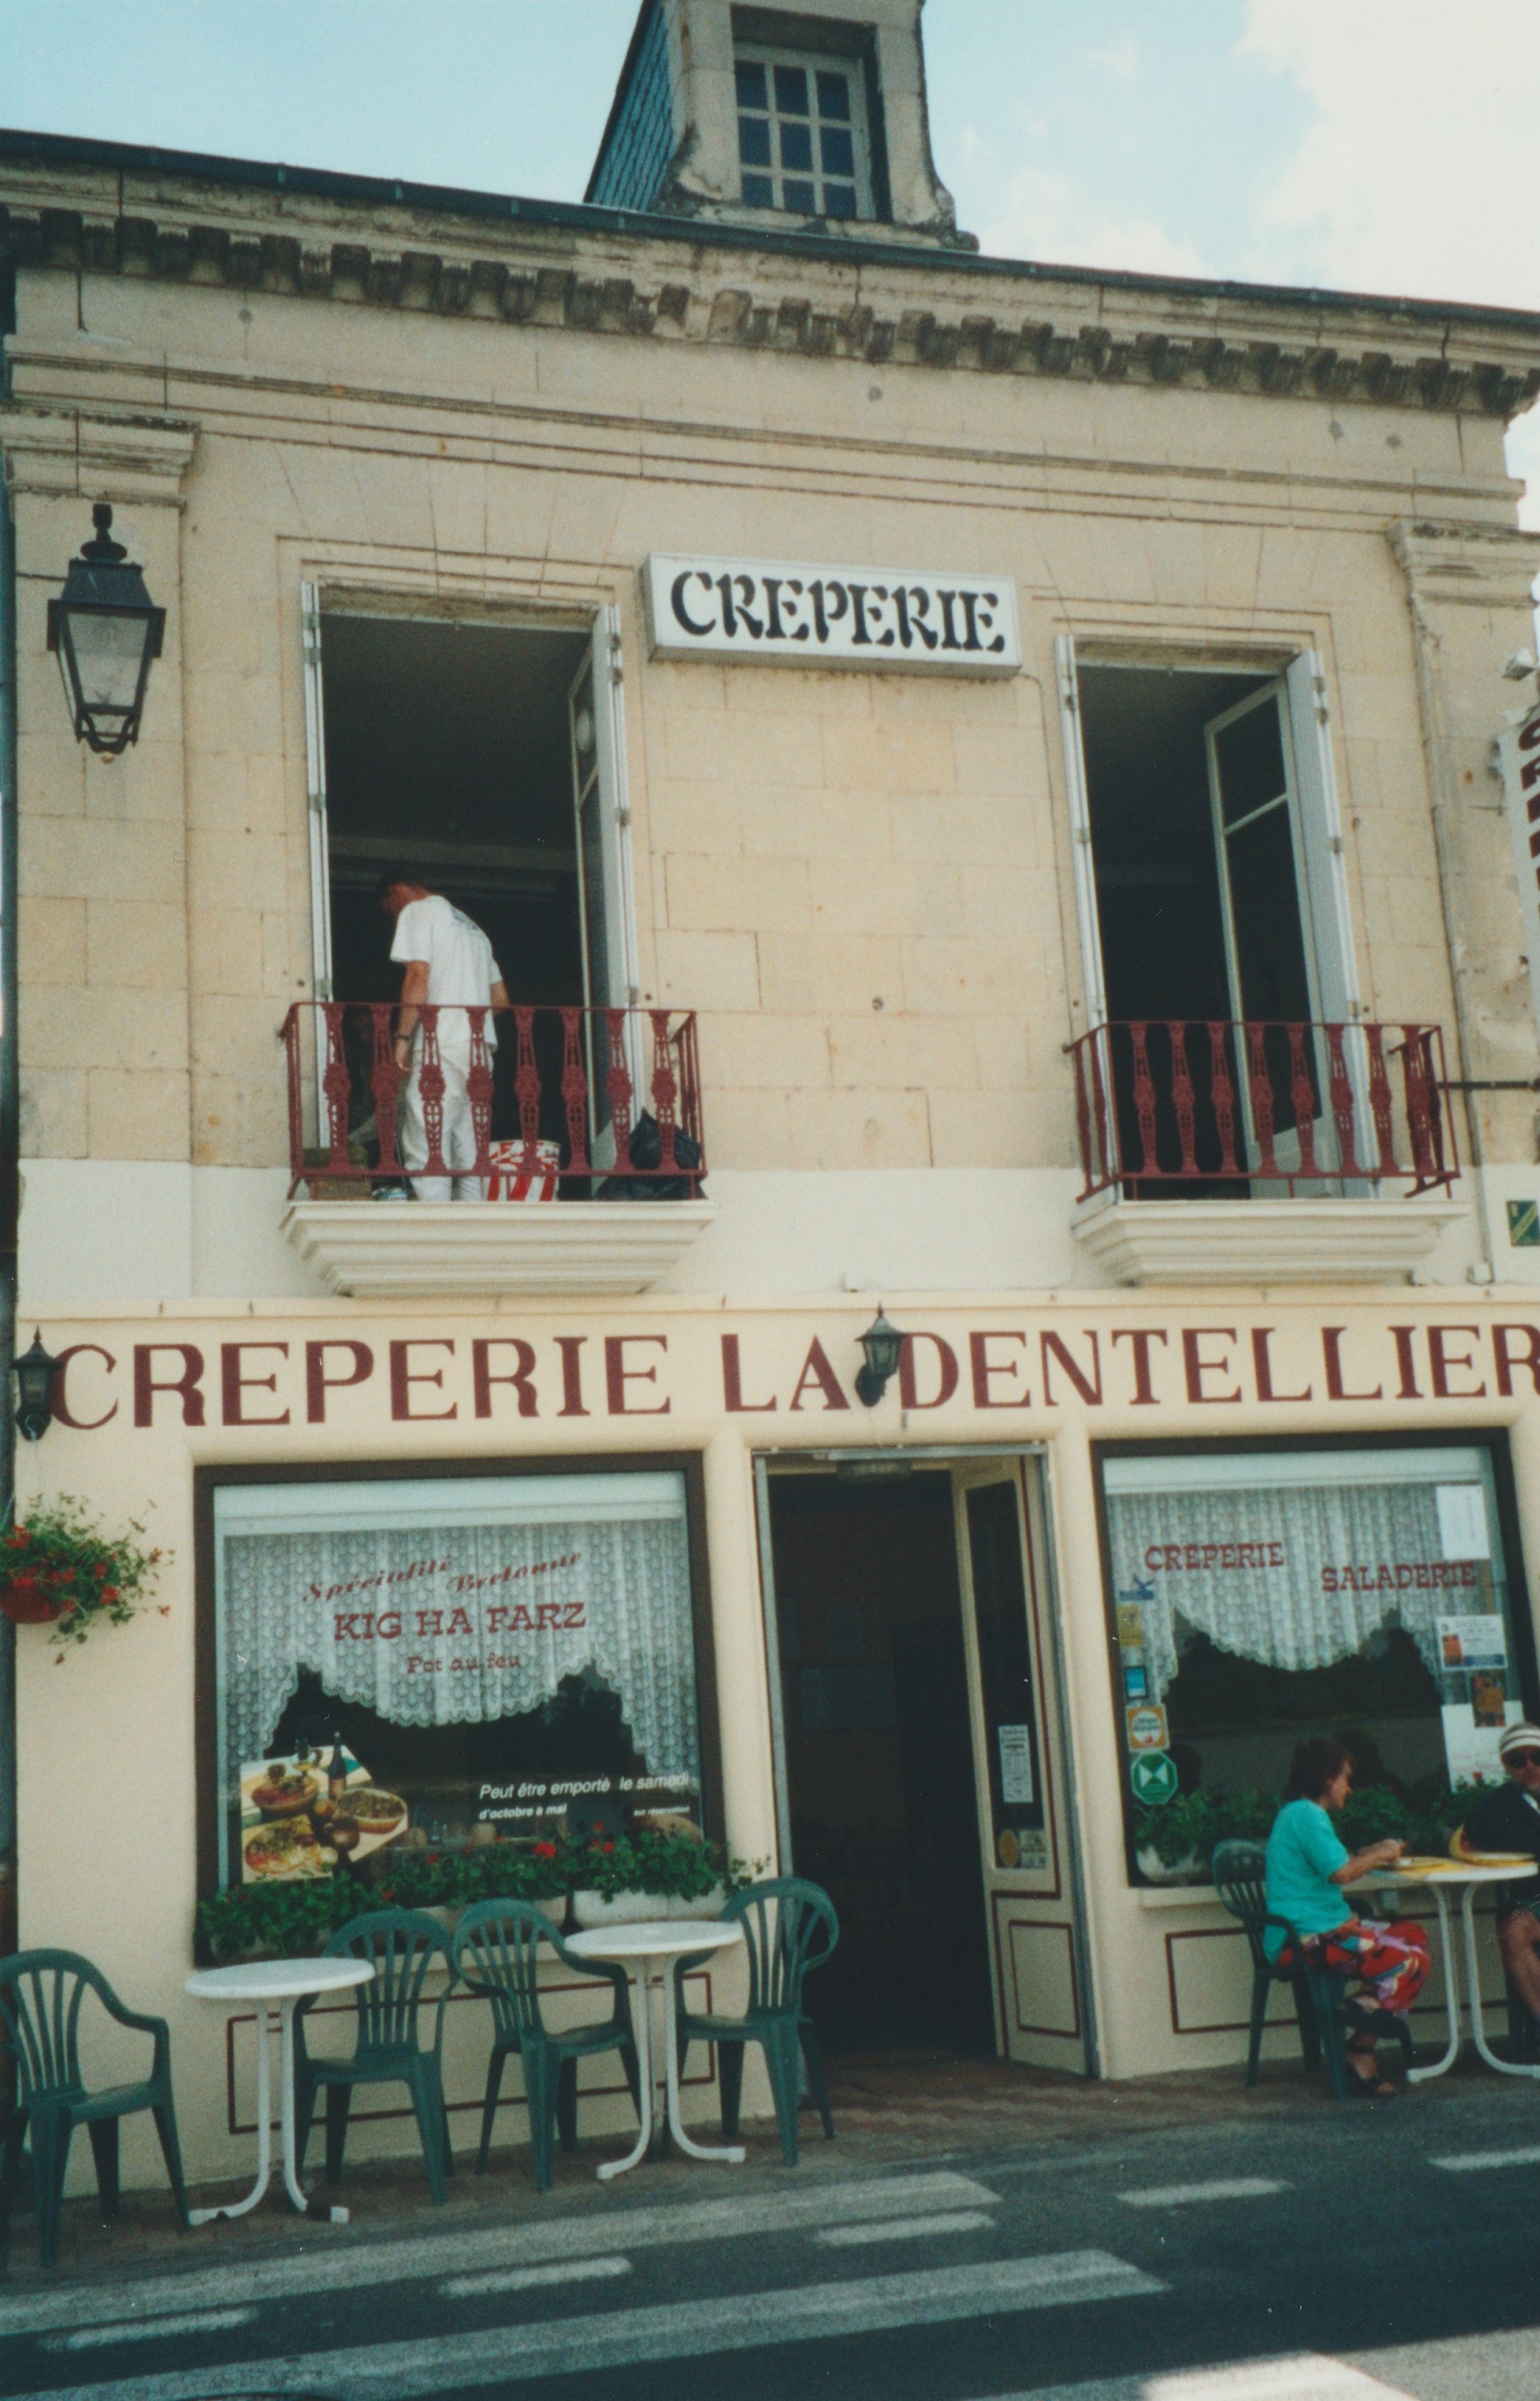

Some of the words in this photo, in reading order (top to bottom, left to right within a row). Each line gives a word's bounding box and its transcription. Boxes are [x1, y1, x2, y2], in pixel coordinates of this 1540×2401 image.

[670, 570, 1006, 653] CREPERIE
[53, 1334, 672, 1430] CREPERIE
[721, 1334, 850, 1413] LA
[897, 1323, 1540, 1411] DENTELLIER
[1144, 1541, 1284, 1572] CREPERIE
[1320, 1561, 1477, 1593] SALADERIE
[333, 1611, 403, 1641] KIG
[415, 1606, 474, 1637] HA
[486, 1601, 587, 1634] FARZ
[406, 1655, 443, 1674] Pot
[450, 1657, 478, 1671] au
[486, 1651, 521, 1669] feu
[479, 1784, 514, 1800] Peut
[517, 1782, 547, 1798] être
[618, 1776, 634, 1791] le
[636, 1771, 689, 1790] samedi
[479, 1806, 534, 1820] d'octobre
[545, 1803, 568, 1815] mai
